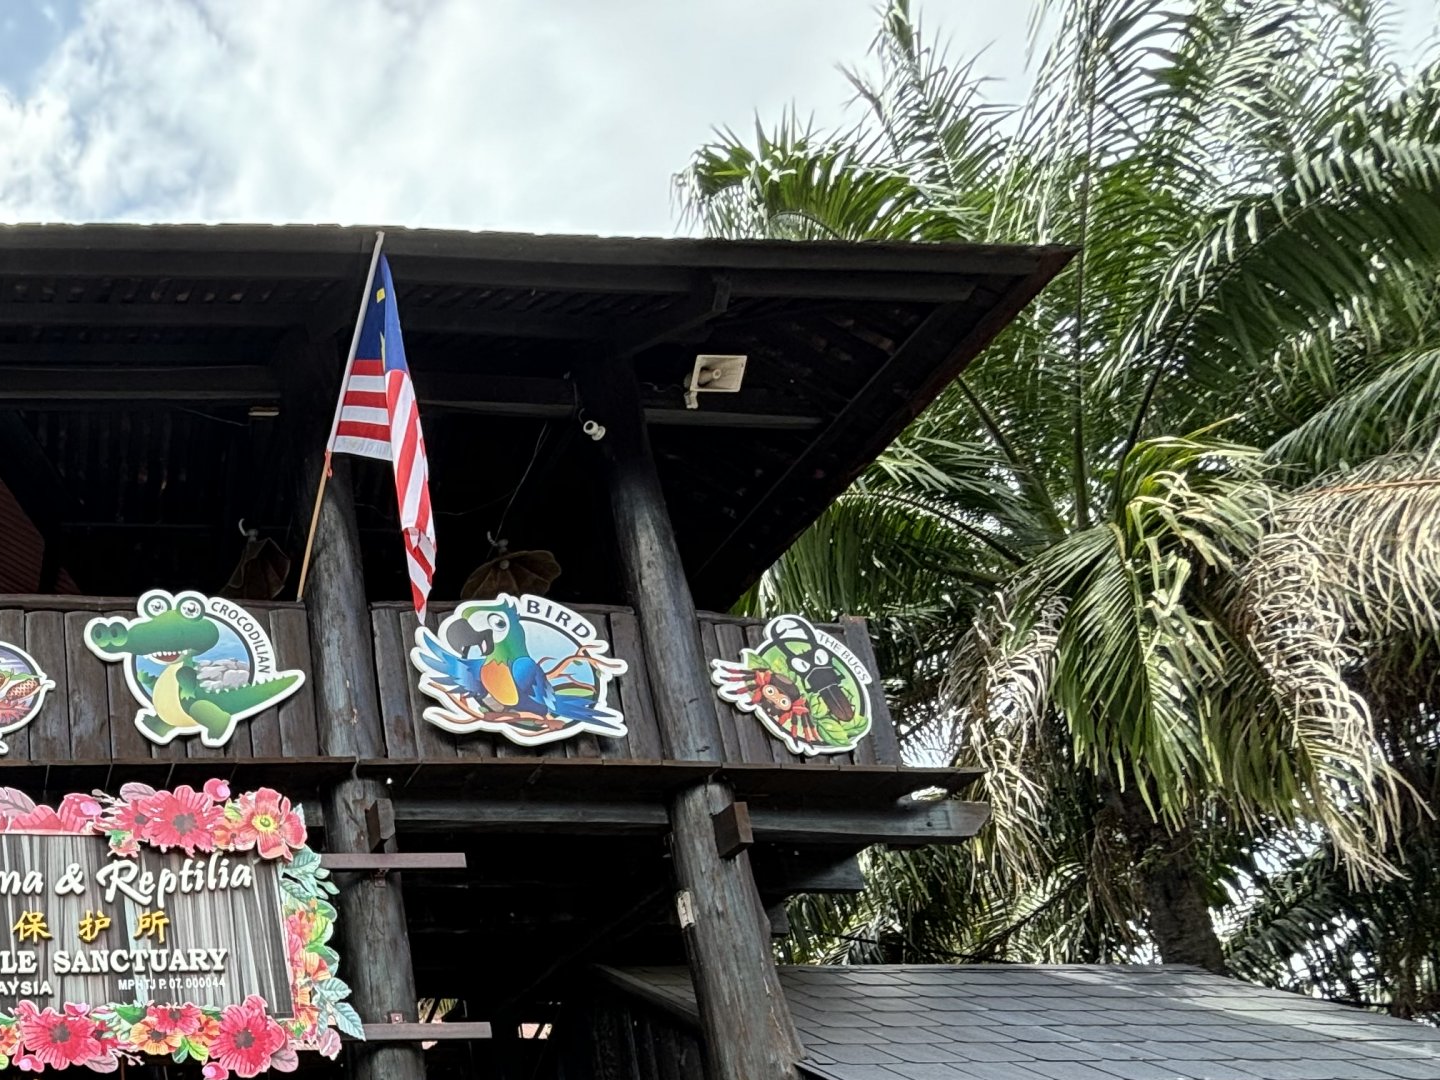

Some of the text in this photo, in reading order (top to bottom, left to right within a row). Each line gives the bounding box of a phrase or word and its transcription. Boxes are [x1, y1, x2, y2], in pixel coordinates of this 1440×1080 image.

[211, 601, 270, 673] CROCODILIAN
[527, 600, 591, 638] BIRD
[818, 631, 868, 682] THE BUGS
[54, 862, 86, 895] &
[95, 851, 253, 909] Reptilia
[53, 948, 229, 975] SANCTUARY
[118, 979, 156, 991] MPHTJ
